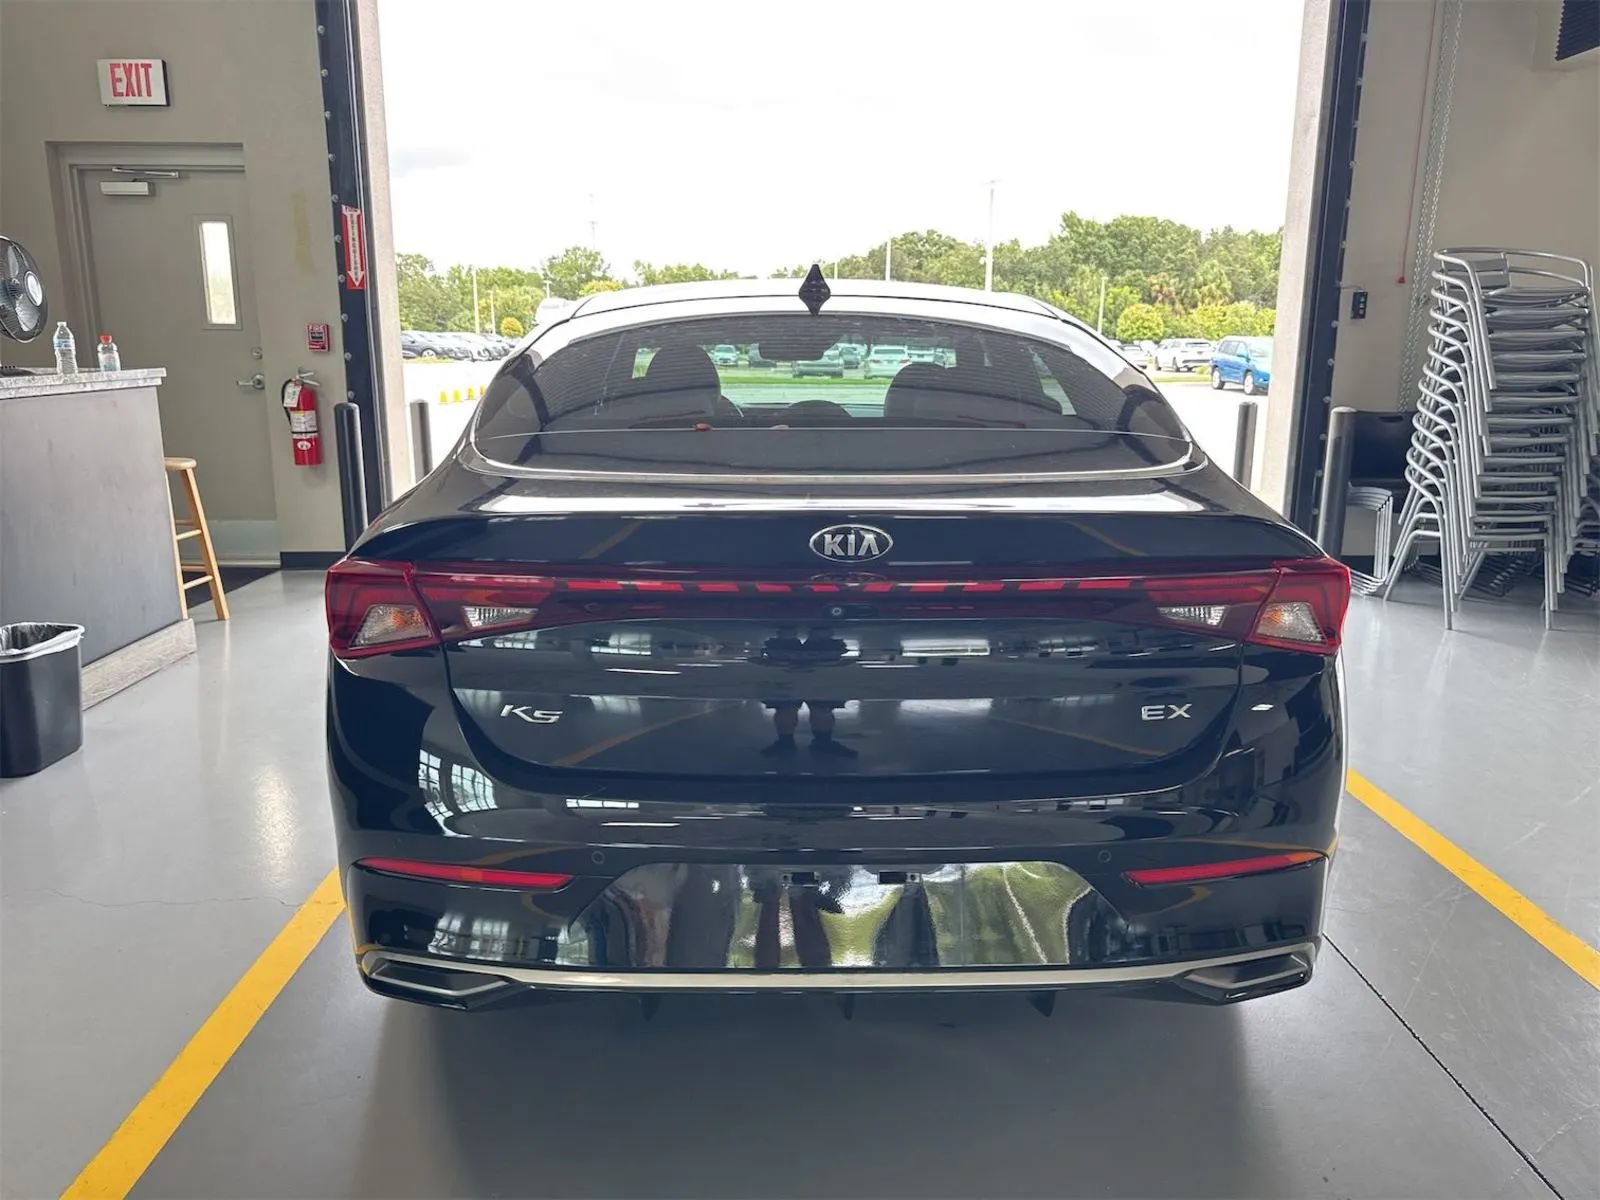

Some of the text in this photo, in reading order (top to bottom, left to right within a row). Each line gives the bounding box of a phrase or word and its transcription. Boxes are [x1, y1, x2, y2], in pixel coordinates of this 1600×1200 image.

[110, 63, 152, 97] EXIT
[823, 531, 880, 556] KIA
[1141, 703, 1192, 720] EX
